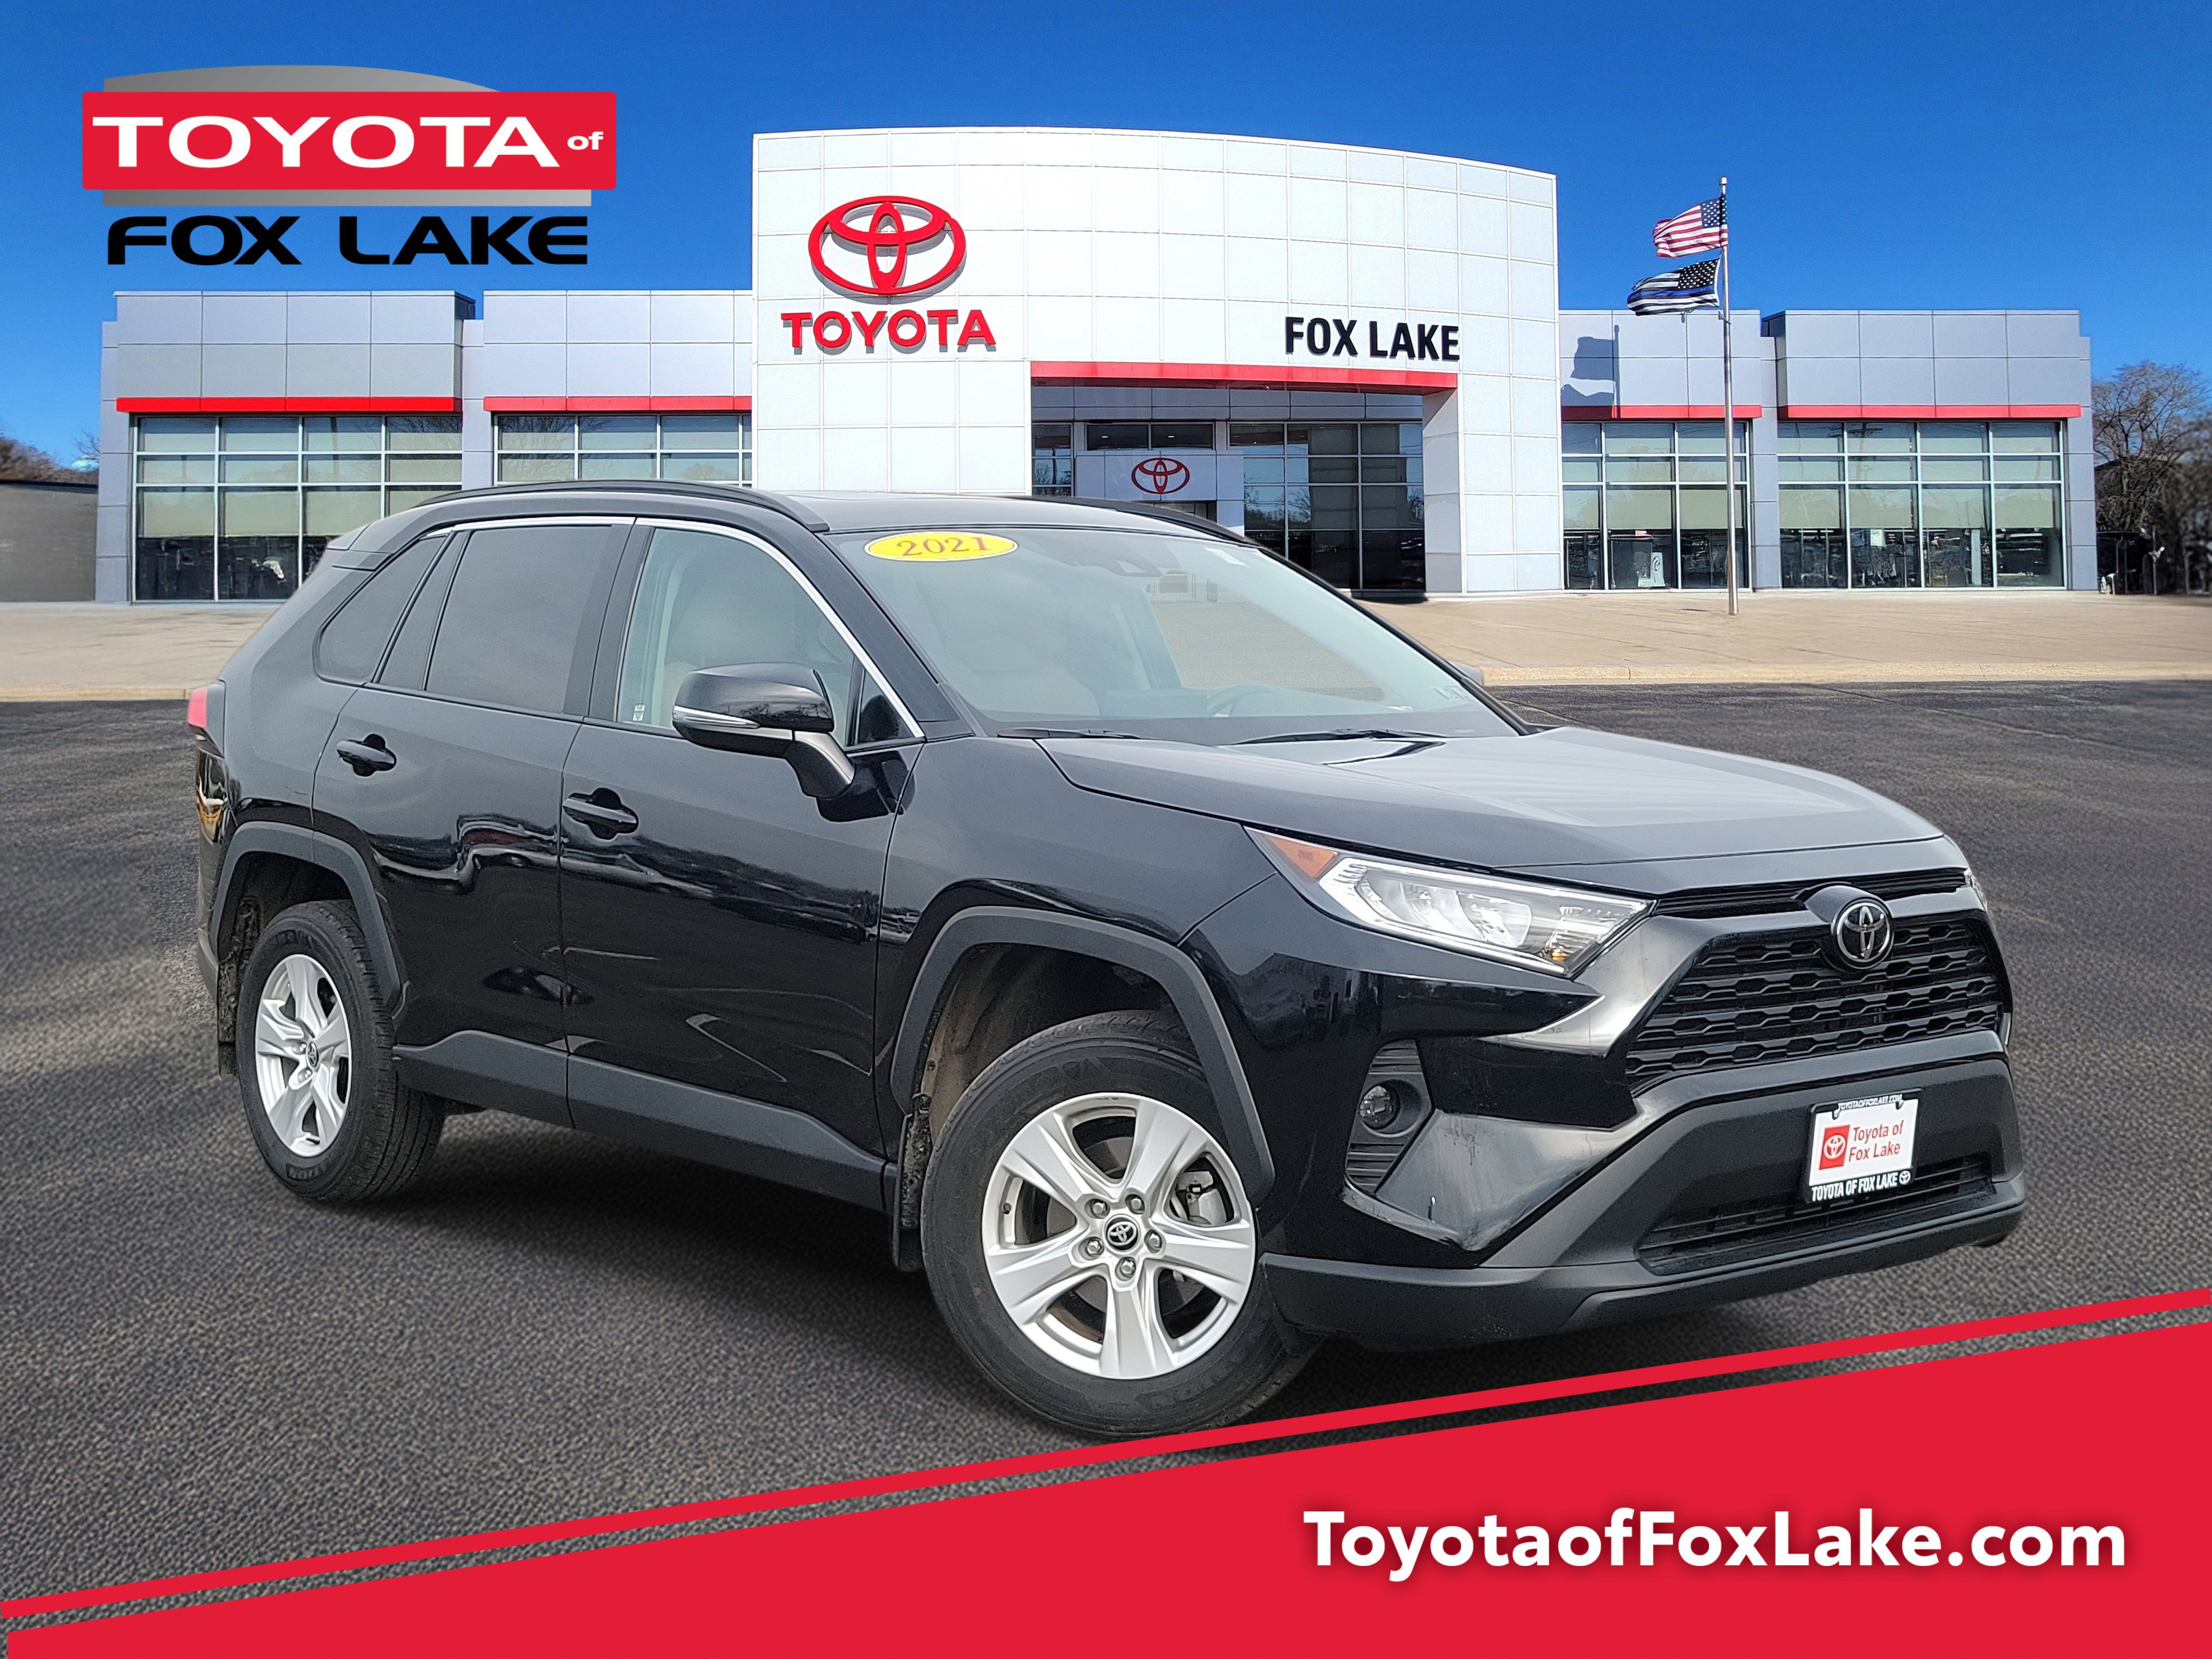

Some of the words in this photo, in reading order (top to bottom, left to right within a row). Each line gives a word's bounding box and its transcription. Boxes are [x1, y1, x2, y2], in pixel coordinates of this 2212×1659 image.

[781, 309, 996, 349] TOYOTA
[1286, 317, 1358, 357] FOX
[1370, 321, 1460, 361] LAKE
[896, 537, 991, 557] 2021
[1853, 1123, 1889, 1144] Toyota
[1892, 1120, 1904, 1135] of
[1848, 1146, 1870, 1162] Fox
[1873, 1141, 1901, 1158] Lake
[1811, 1181, 1844, 1202] TOYOTA
[1845, 1179, 1858, 1196] OF
[1858, 1176, 1875, 1194] FOX
[1876, 1172, 1899, 1190] LAKE
